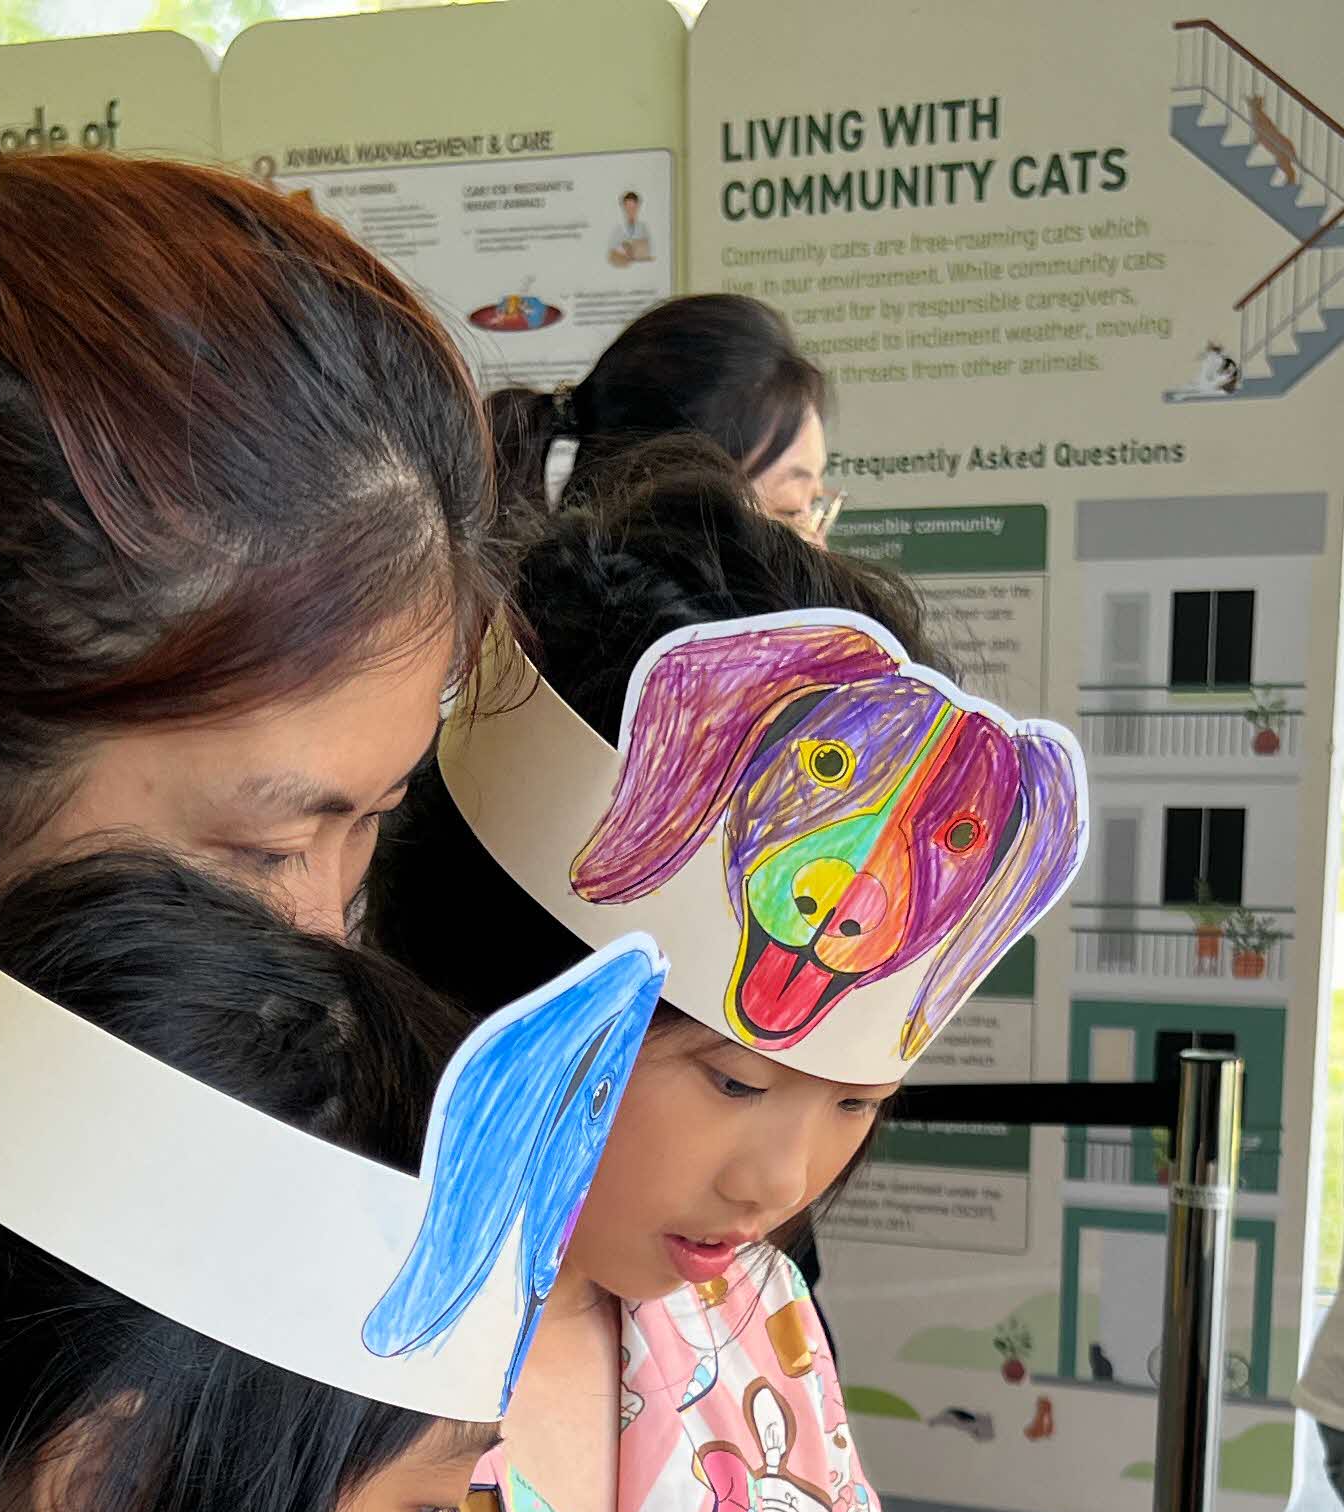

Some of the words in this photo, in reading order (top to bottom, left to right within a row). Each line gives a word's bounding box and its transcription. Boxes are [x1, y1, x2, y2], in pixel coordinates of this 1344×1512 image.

[81, 96, 120, 149] of
[721, 109, 864, 163] LIVING
[878, 96, 1000, 148] WITH
[721, 157, 996, 222] COMMUNITY
[1009, 147, 1128, 199] CATS
[721, 242, 826, 267] Community
[830, 239, 870, 260] cats
[873, 239, 906, 257] are
[910, 229, 1038, 250] free-roaming
[1042, 223, 1083, 245] cats
[1088, 216, 1150, 241] which
[783, 277, 814, 294] our
[817, 266, 943, 291] environment.
[946, 260, 1003, 282] While
[1007, 252, 1121, 278] community
[1123, 251, 1168, 271] cats
[849, 301, 877, 321] for
[880, 299, 903, 323] by
[908, 291, 1020, 319] responsible
[882, 333, 902, 350] to
[1005, 320, 1092, 344] weather,
[1096, 313, 1172, 340] moving
[911, 359, 959, 380] from
[961, 356, 1015, 379] other
[826, 448, 960, 479] Frequently
[967, 443, 1047, 471] Asked
[1054, 438, 1186, 469] Questions
[915, 514, 1005, 535] community
